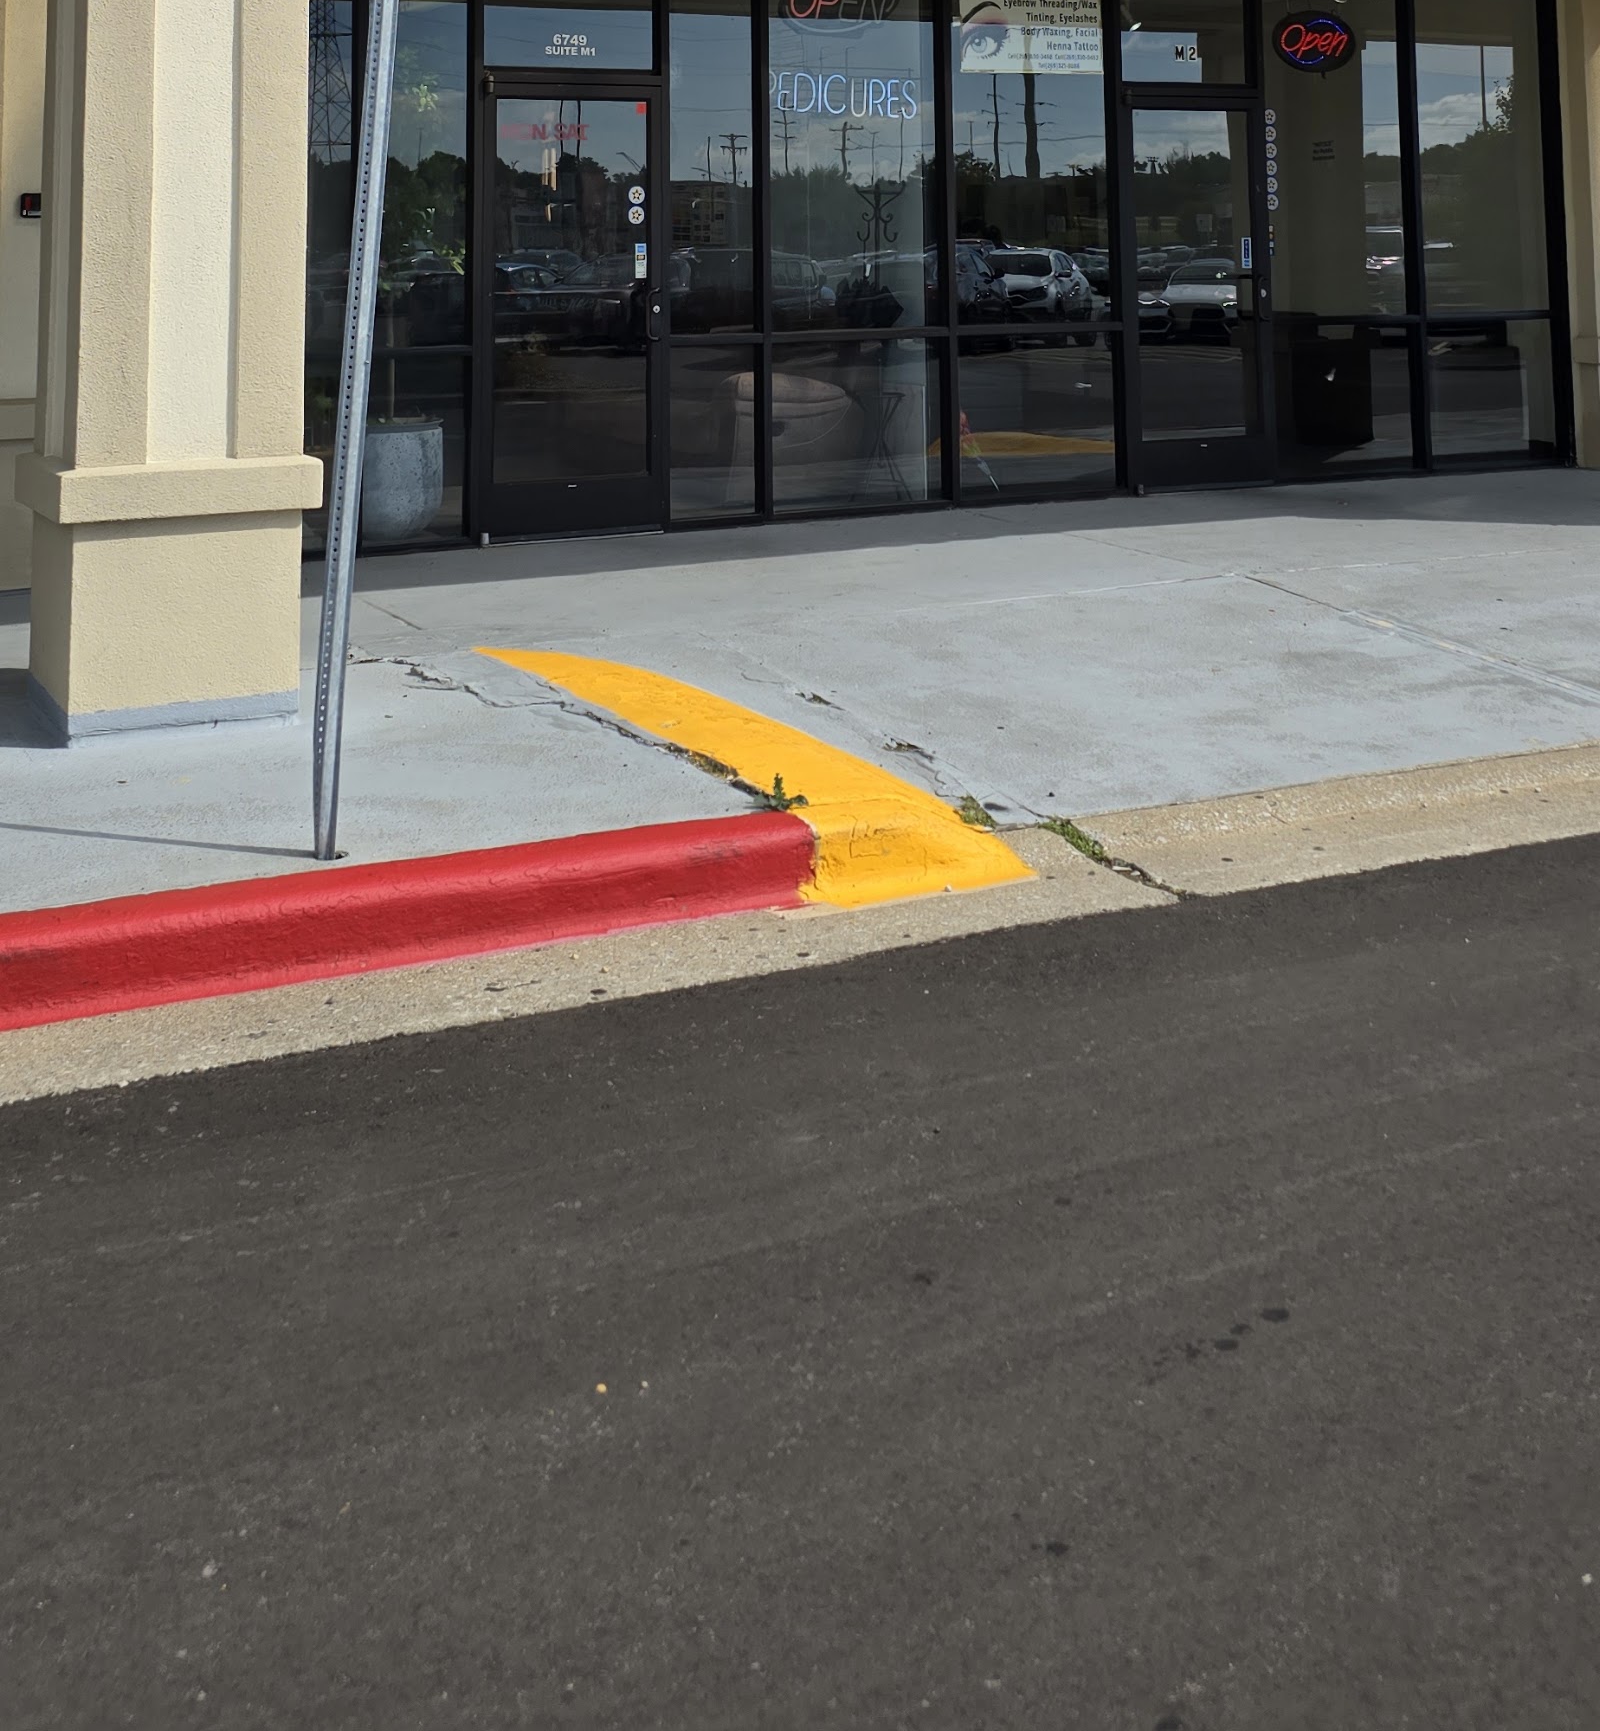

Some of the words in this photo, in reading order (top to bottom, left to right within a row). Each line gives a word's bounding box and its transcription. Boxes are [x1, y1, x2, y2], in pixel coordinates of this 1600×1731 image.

[1059, 13, 1098, 24] Eyelashes
[1021, 27, 1041, 38] Body
[1075, 28, 1098, 37] Facial
[553, 33, 588, 46] 6749
[1280, 24, 1349, 58] Open
[545, 45, 579, 56] SUITE
[580, 47, 596, 56] M1
[1046, 41, 1072, 51] Henna
[1073, 42, 1099, 51] Tattoo
[554, 123, 590, 141] SAT
